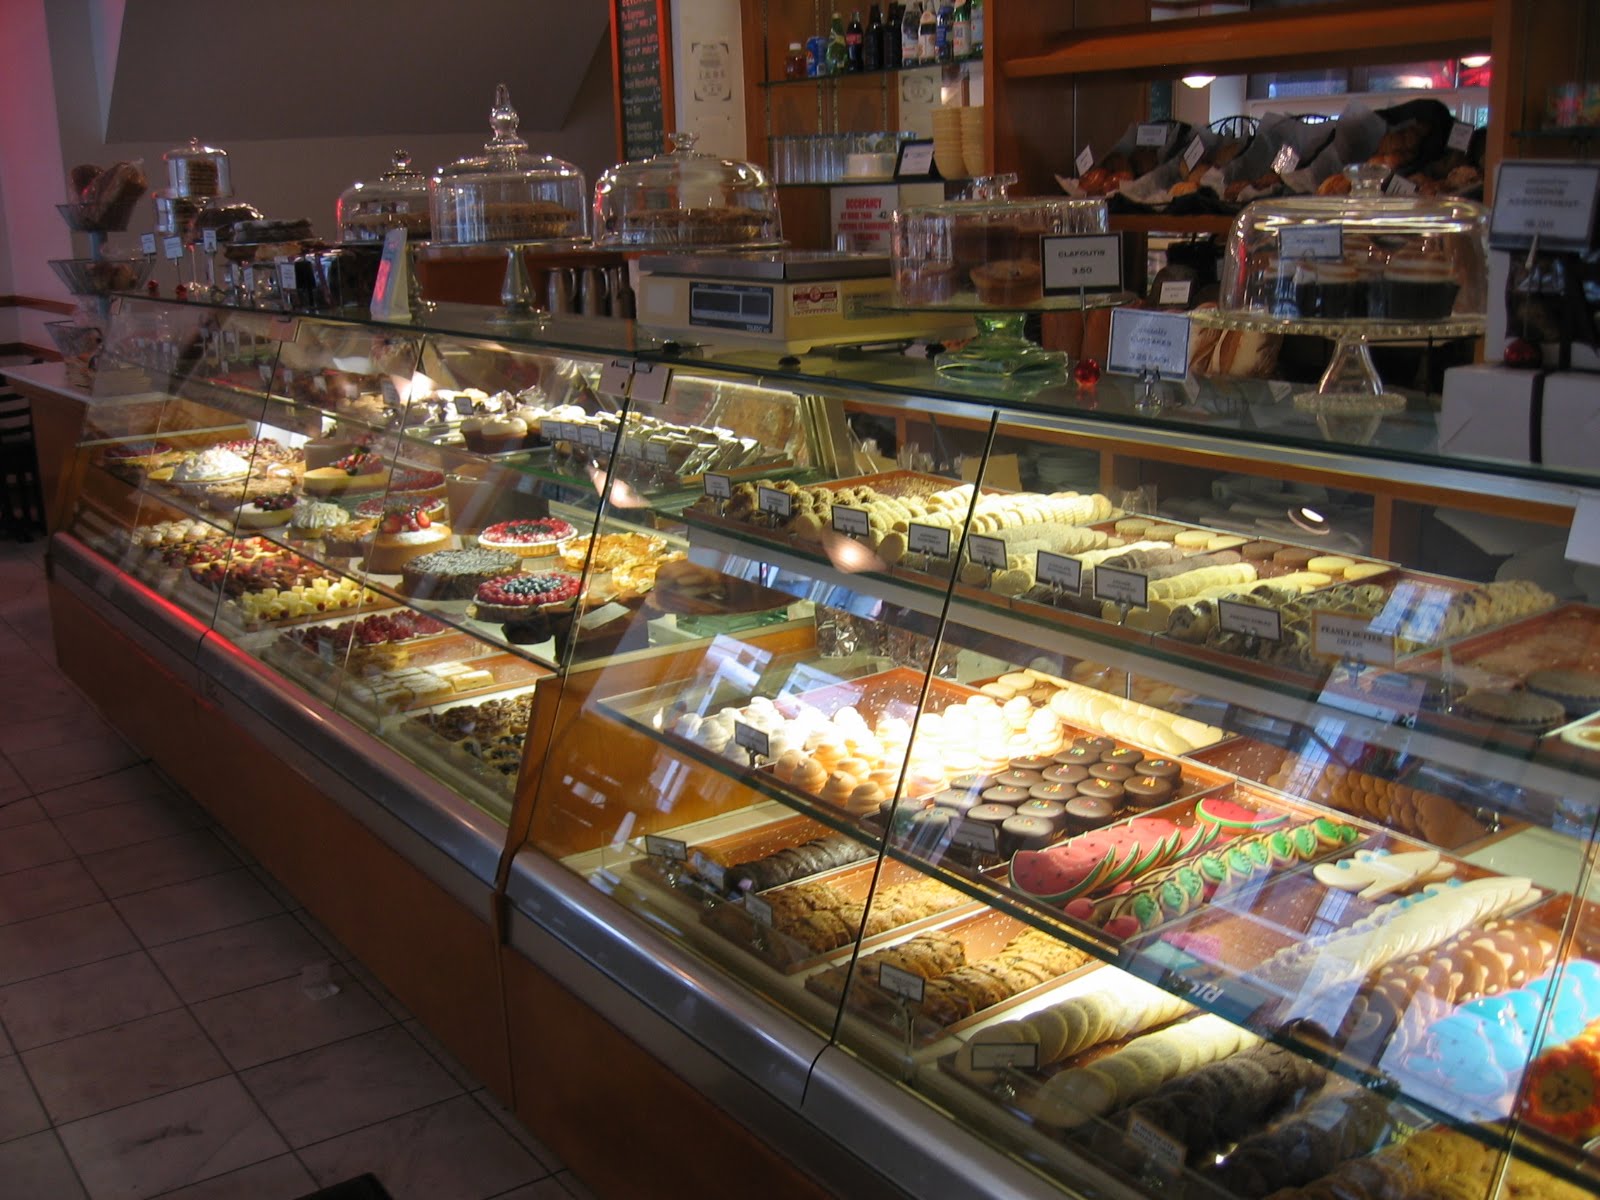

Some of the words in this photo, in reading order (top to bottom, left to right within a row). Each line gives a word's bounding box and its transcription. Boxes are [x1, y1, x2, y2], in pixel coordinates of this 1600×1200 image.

[846, 198, 882, 209] OCCUPANCY
[1057, 249, 1106, 258] CLAFOUTIS
[1321, 626, 1351, 638] PEANUT
